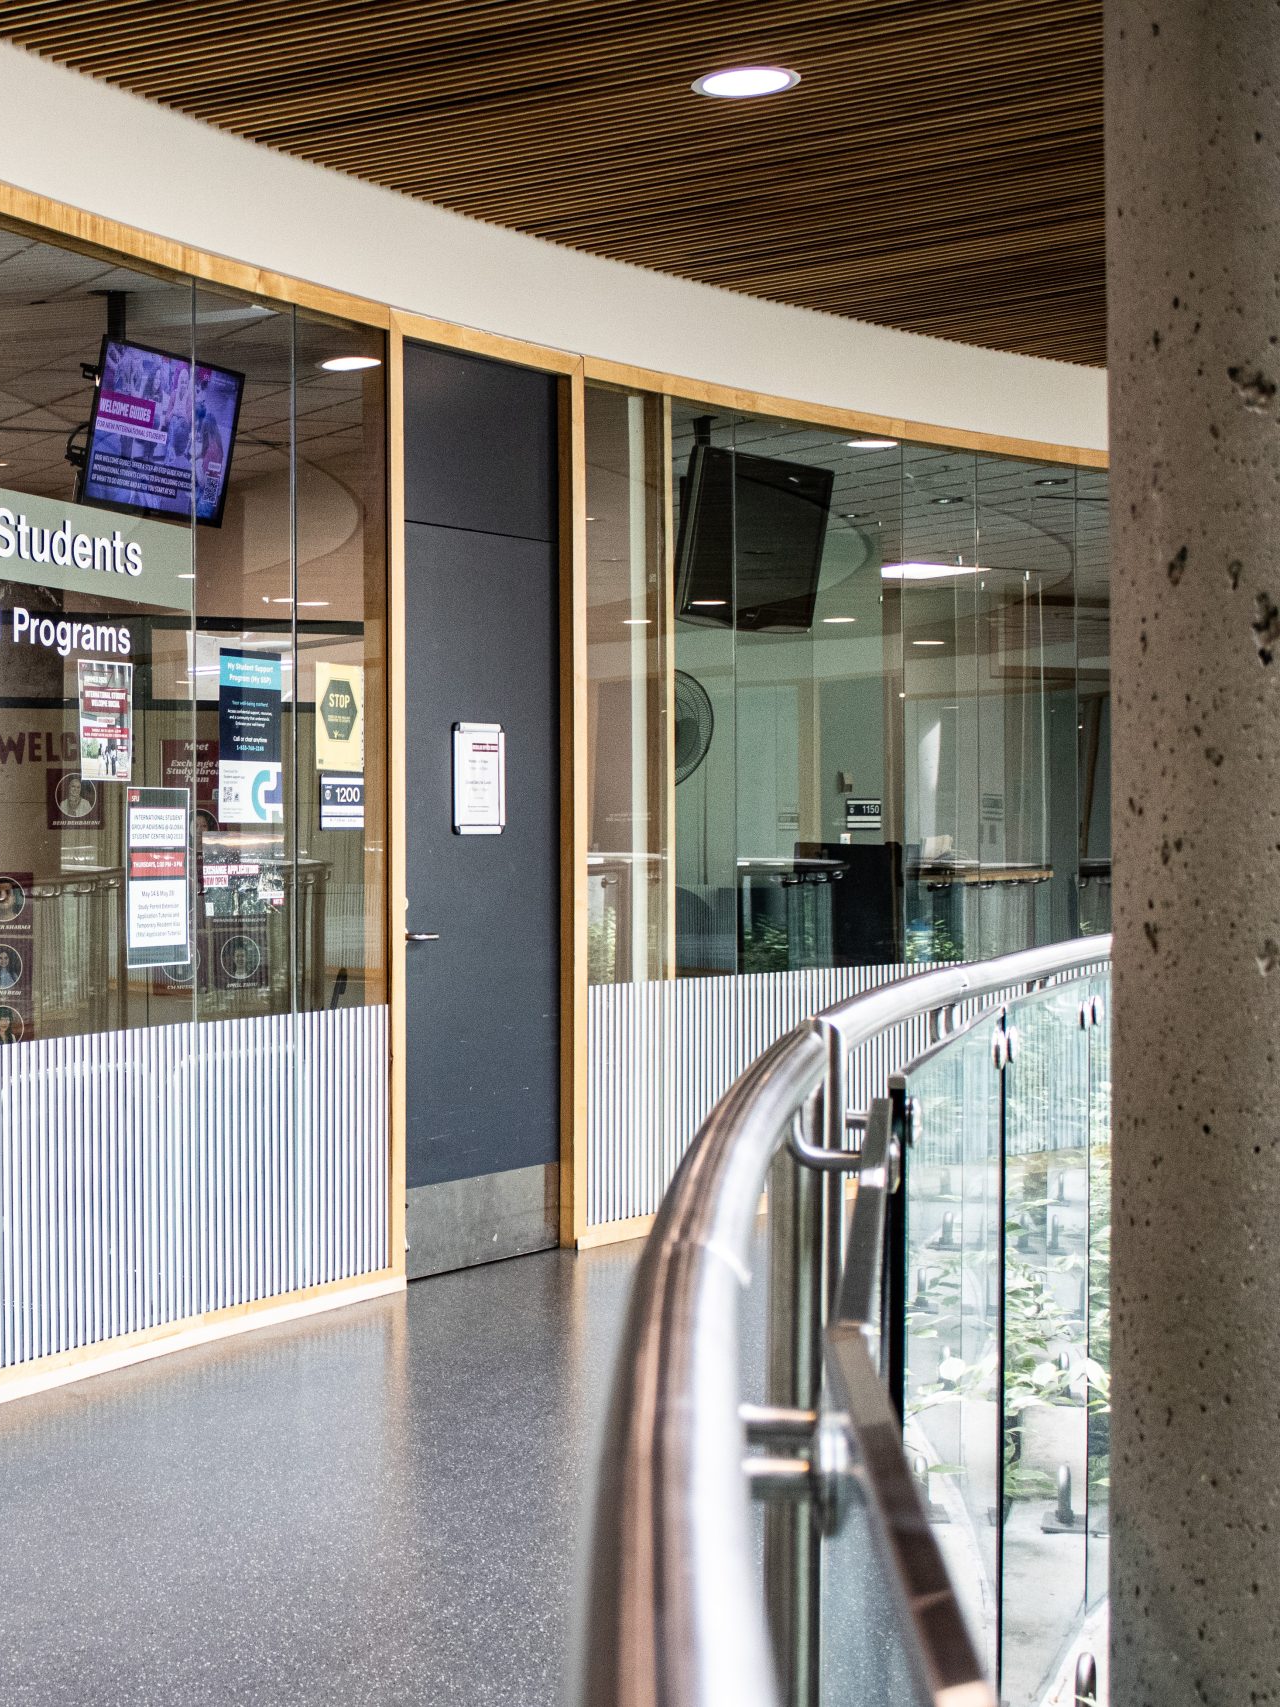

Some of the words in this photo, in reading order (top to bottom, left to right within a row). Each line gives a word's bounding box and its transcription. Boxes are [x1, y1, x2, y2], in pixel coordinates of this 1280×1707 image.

[13, 607, 132, 656] Programs
[236, 663, 254, 671] Student
[255, 665, 273, 673] Support
[229, 674, 251, 683] Program
[328, 693, 351, 708] STOP
[171, 760, 214, 769] Exchnge
[335, 786, 361, 803] 1200
[862, 804, 880, 814] 1150
